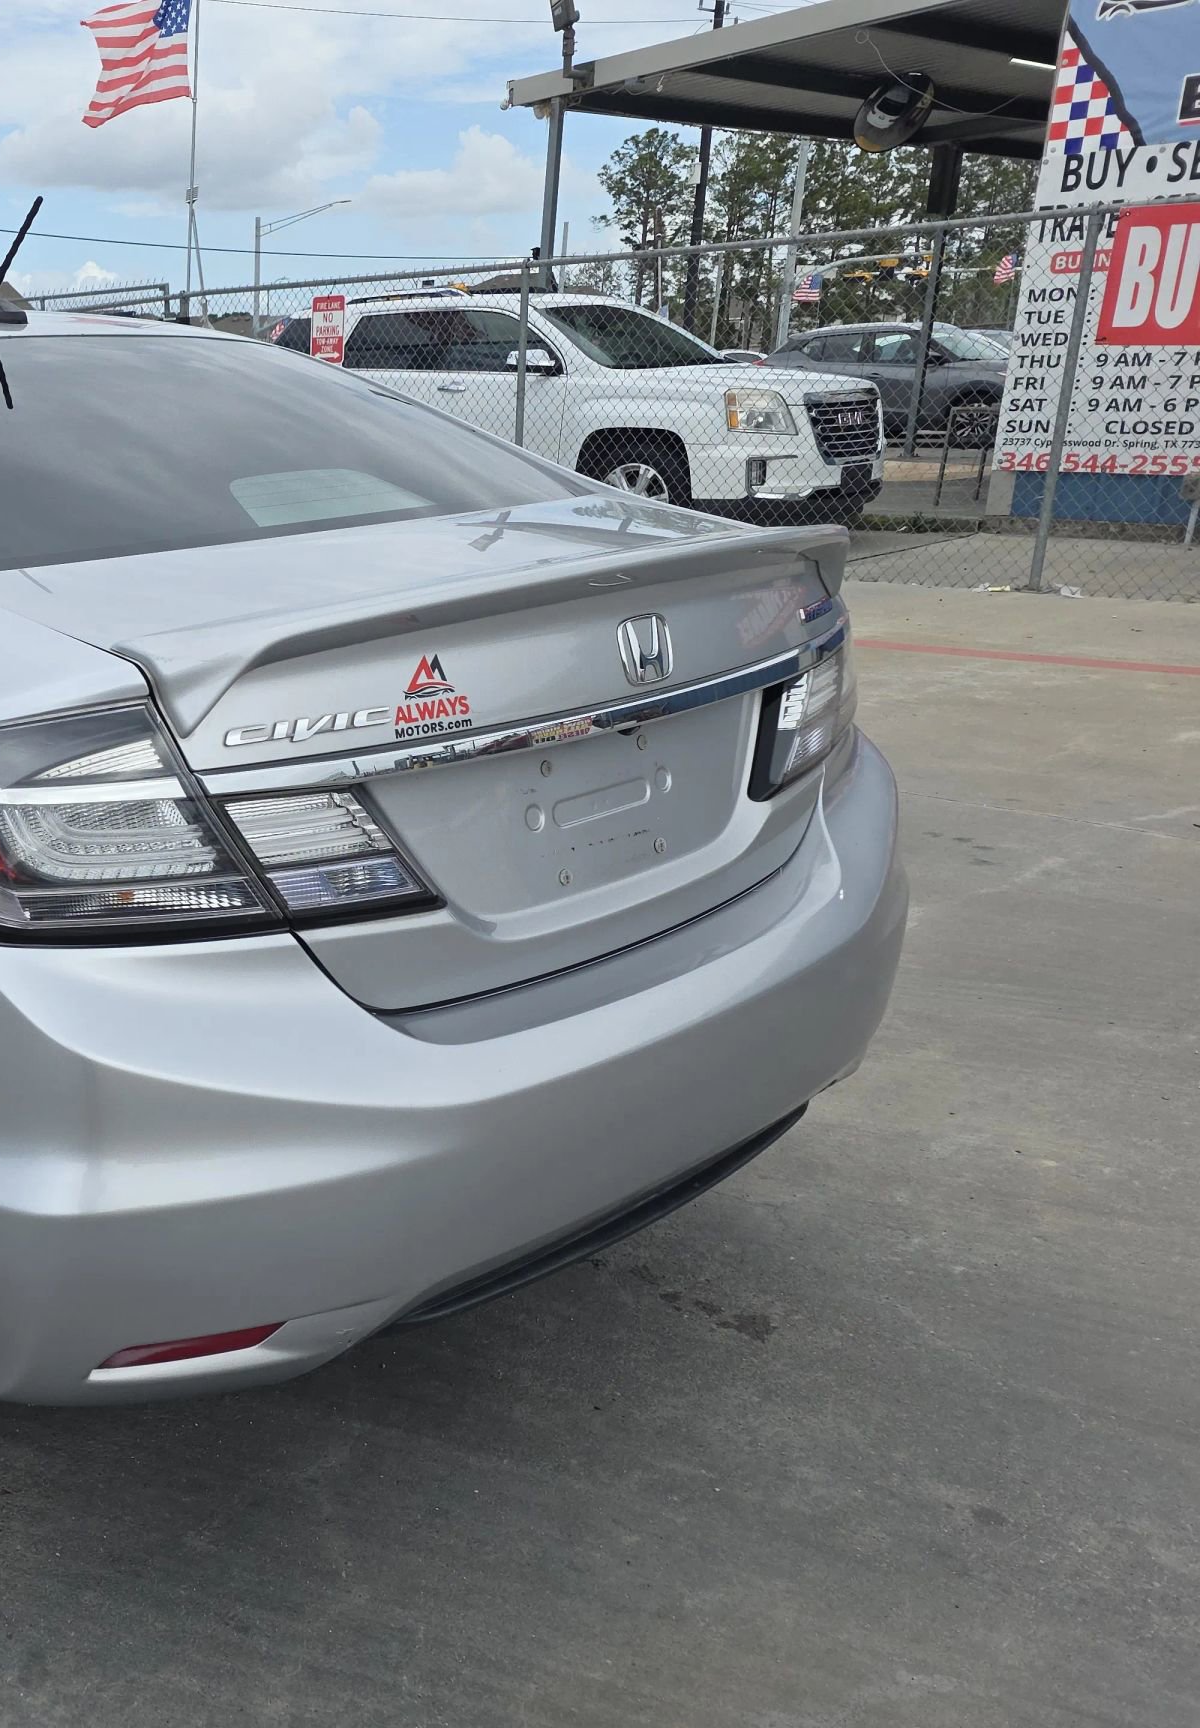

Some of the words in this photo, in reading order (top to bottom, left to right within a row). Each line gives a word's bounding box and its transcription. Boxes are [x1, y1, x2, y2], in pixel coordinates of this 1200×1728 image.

[1060, 146, 1139, 193] BUY
[1027, 287, 1079, 303] MON
[317, 302, 328, 310] FIRE
[328, 301, 341, 310] LANE
[323, 312, 333, 323] NO
[1024, 310, 1065, 326] TUE
[316, 325, 340, 336] PARKING
[1020, 332, 1069, 347] WED
[1017, 354, 1062, 369] THU
[1095, 353, 1109, 367] 9
[1113, 352, 1152, 367] AM
[1174, 351, 1188, 366] 7
[1012, 376, 1045, 391] FRI
[1091, 375, 1105, 390] 9
[1109, 374, 1147, 390] AM
[1168, 374, 1182, 389] 7
[1008, 398, 1048, 412] SAT
[1087, 398, 1100, 412] 9
[1105, 398, 1143, 413] AM
[1163, 398, 1177, 412] 6
[1005, 419, 1051, 434] SUN
[1105, 420, 1195, 435] CLOSED
[1002, 437, 1032, 448] 23737
[1034, 438, 1101, 449] Cypsswood
[1104, 438, 1120, 449] Dr.
[1122, 439, 1160, 451] Spring,
[1163, 440, 1178, 449] TX
[394, 695, 470, 726] ALWAYS
[224, 705, 392, 747] CIVIC
[394, 717, 473, 740] MOTORS.com
